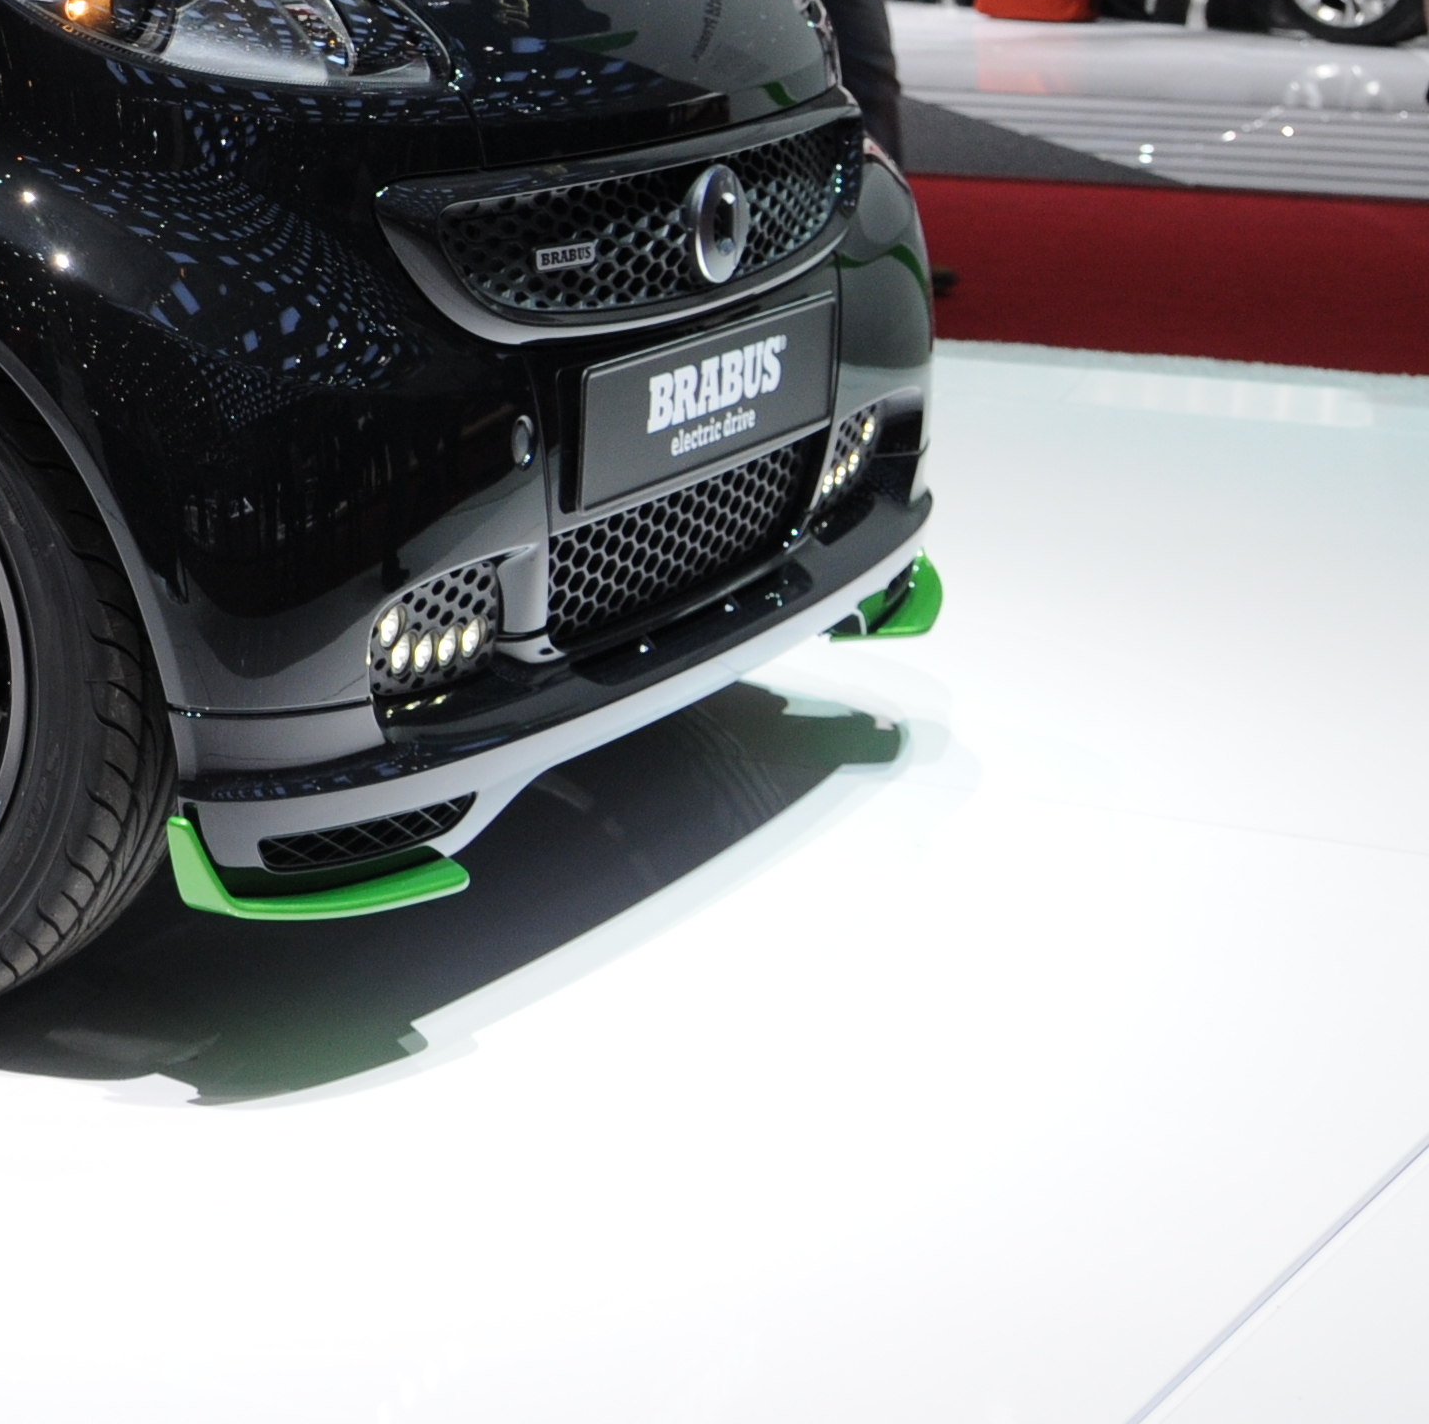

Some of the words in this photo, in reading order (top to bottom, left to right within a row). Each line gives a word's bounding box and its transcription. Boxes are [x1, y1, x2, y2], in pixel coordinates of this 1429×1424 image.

[541, 245, 592, 266] BRABUS
[670, 417, 722, 457] electric
[723, 407, 756, 437] drive
